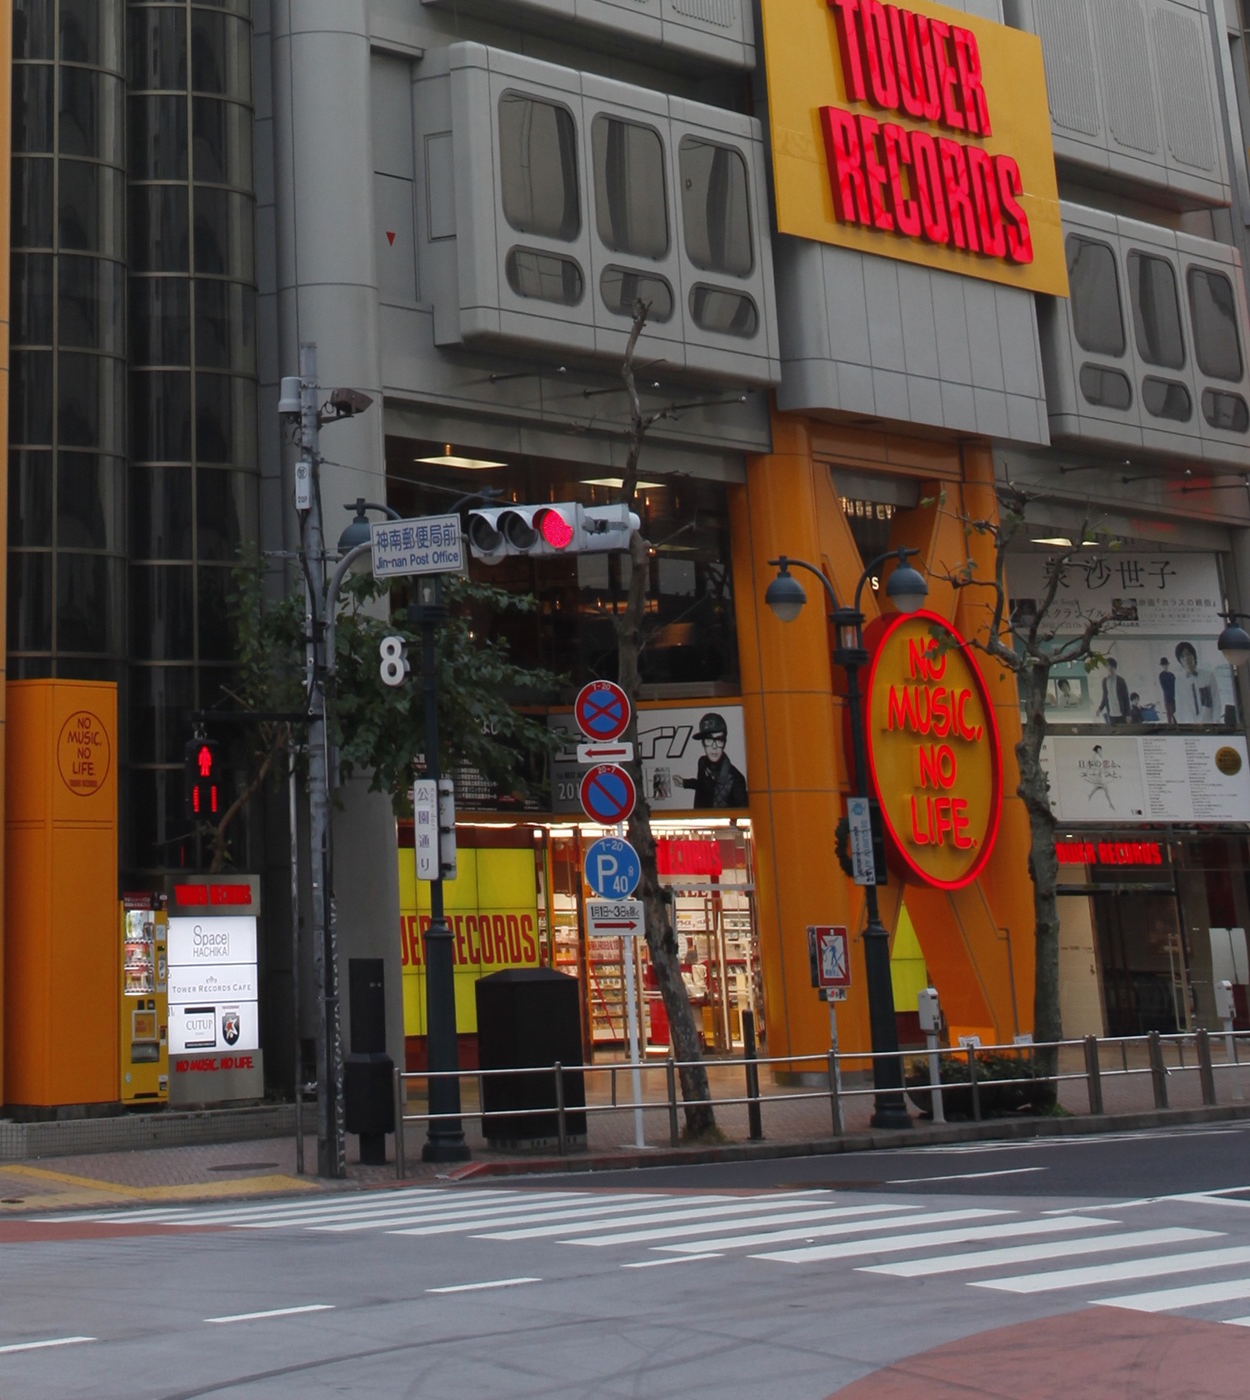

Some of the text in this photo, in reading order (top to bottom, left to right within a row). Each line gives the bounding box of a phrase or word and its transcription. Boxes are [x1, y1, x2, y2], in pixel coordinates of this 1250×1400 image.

[819, 105, 1034, 264] RECORDS
[376, 523, 456, 553] 神南郵便局前
[376, 551, 458, 569] Jin-nan Post Office
[379, 636, 411, 687] 8
[908, 637, 947, 682] NO
[77, 717, 91, 729] NO
[77, 747, 91, 760] NO
[597, 766, 616, 774] 20-7
[919, 745, 957, 790] NO
[417, 787, 431, 872] 公園通り
[599, 840, 624, 851] 7-20
[597, 854, 618, 893] P
[613, 875, 628, 893] 40
[193, 925, 228, 947] Space
[186, 1020, 213, 1031] CUTUP
[176, 1059, 189, 1072] NO
[220, 1057, 233, 1069] NO
